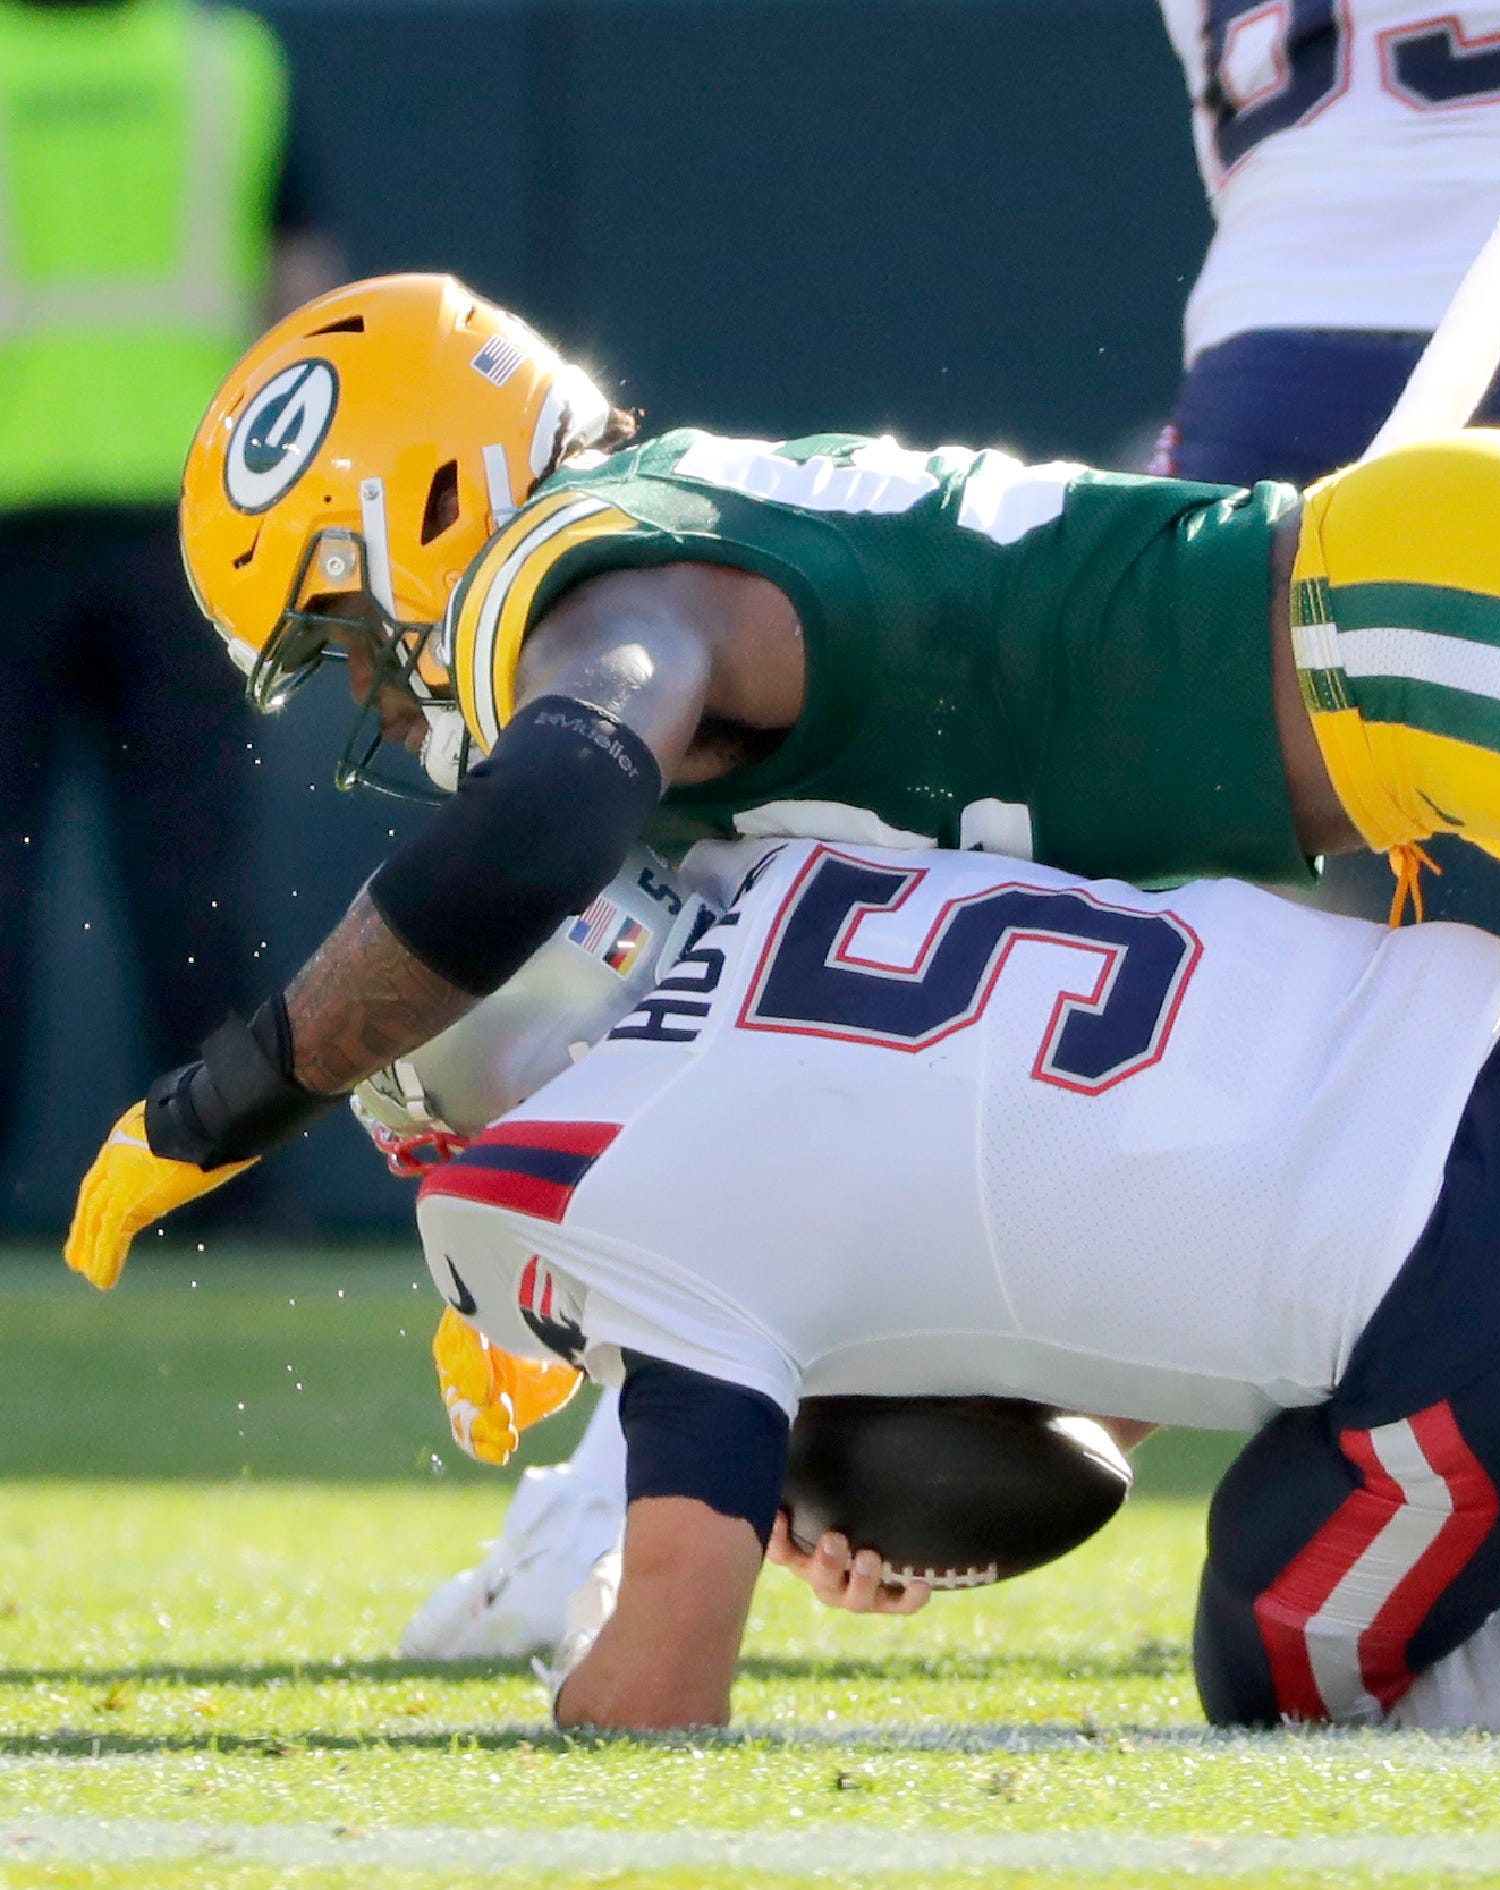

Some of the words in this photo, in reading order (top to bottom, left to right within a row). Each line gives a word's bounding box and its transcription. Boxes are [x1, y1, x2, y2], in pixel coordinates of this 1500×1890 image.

[221, 356, 340, 516] G
[637, 866, 682, 916] 5
[736, 840, 1204, 1096] 5
